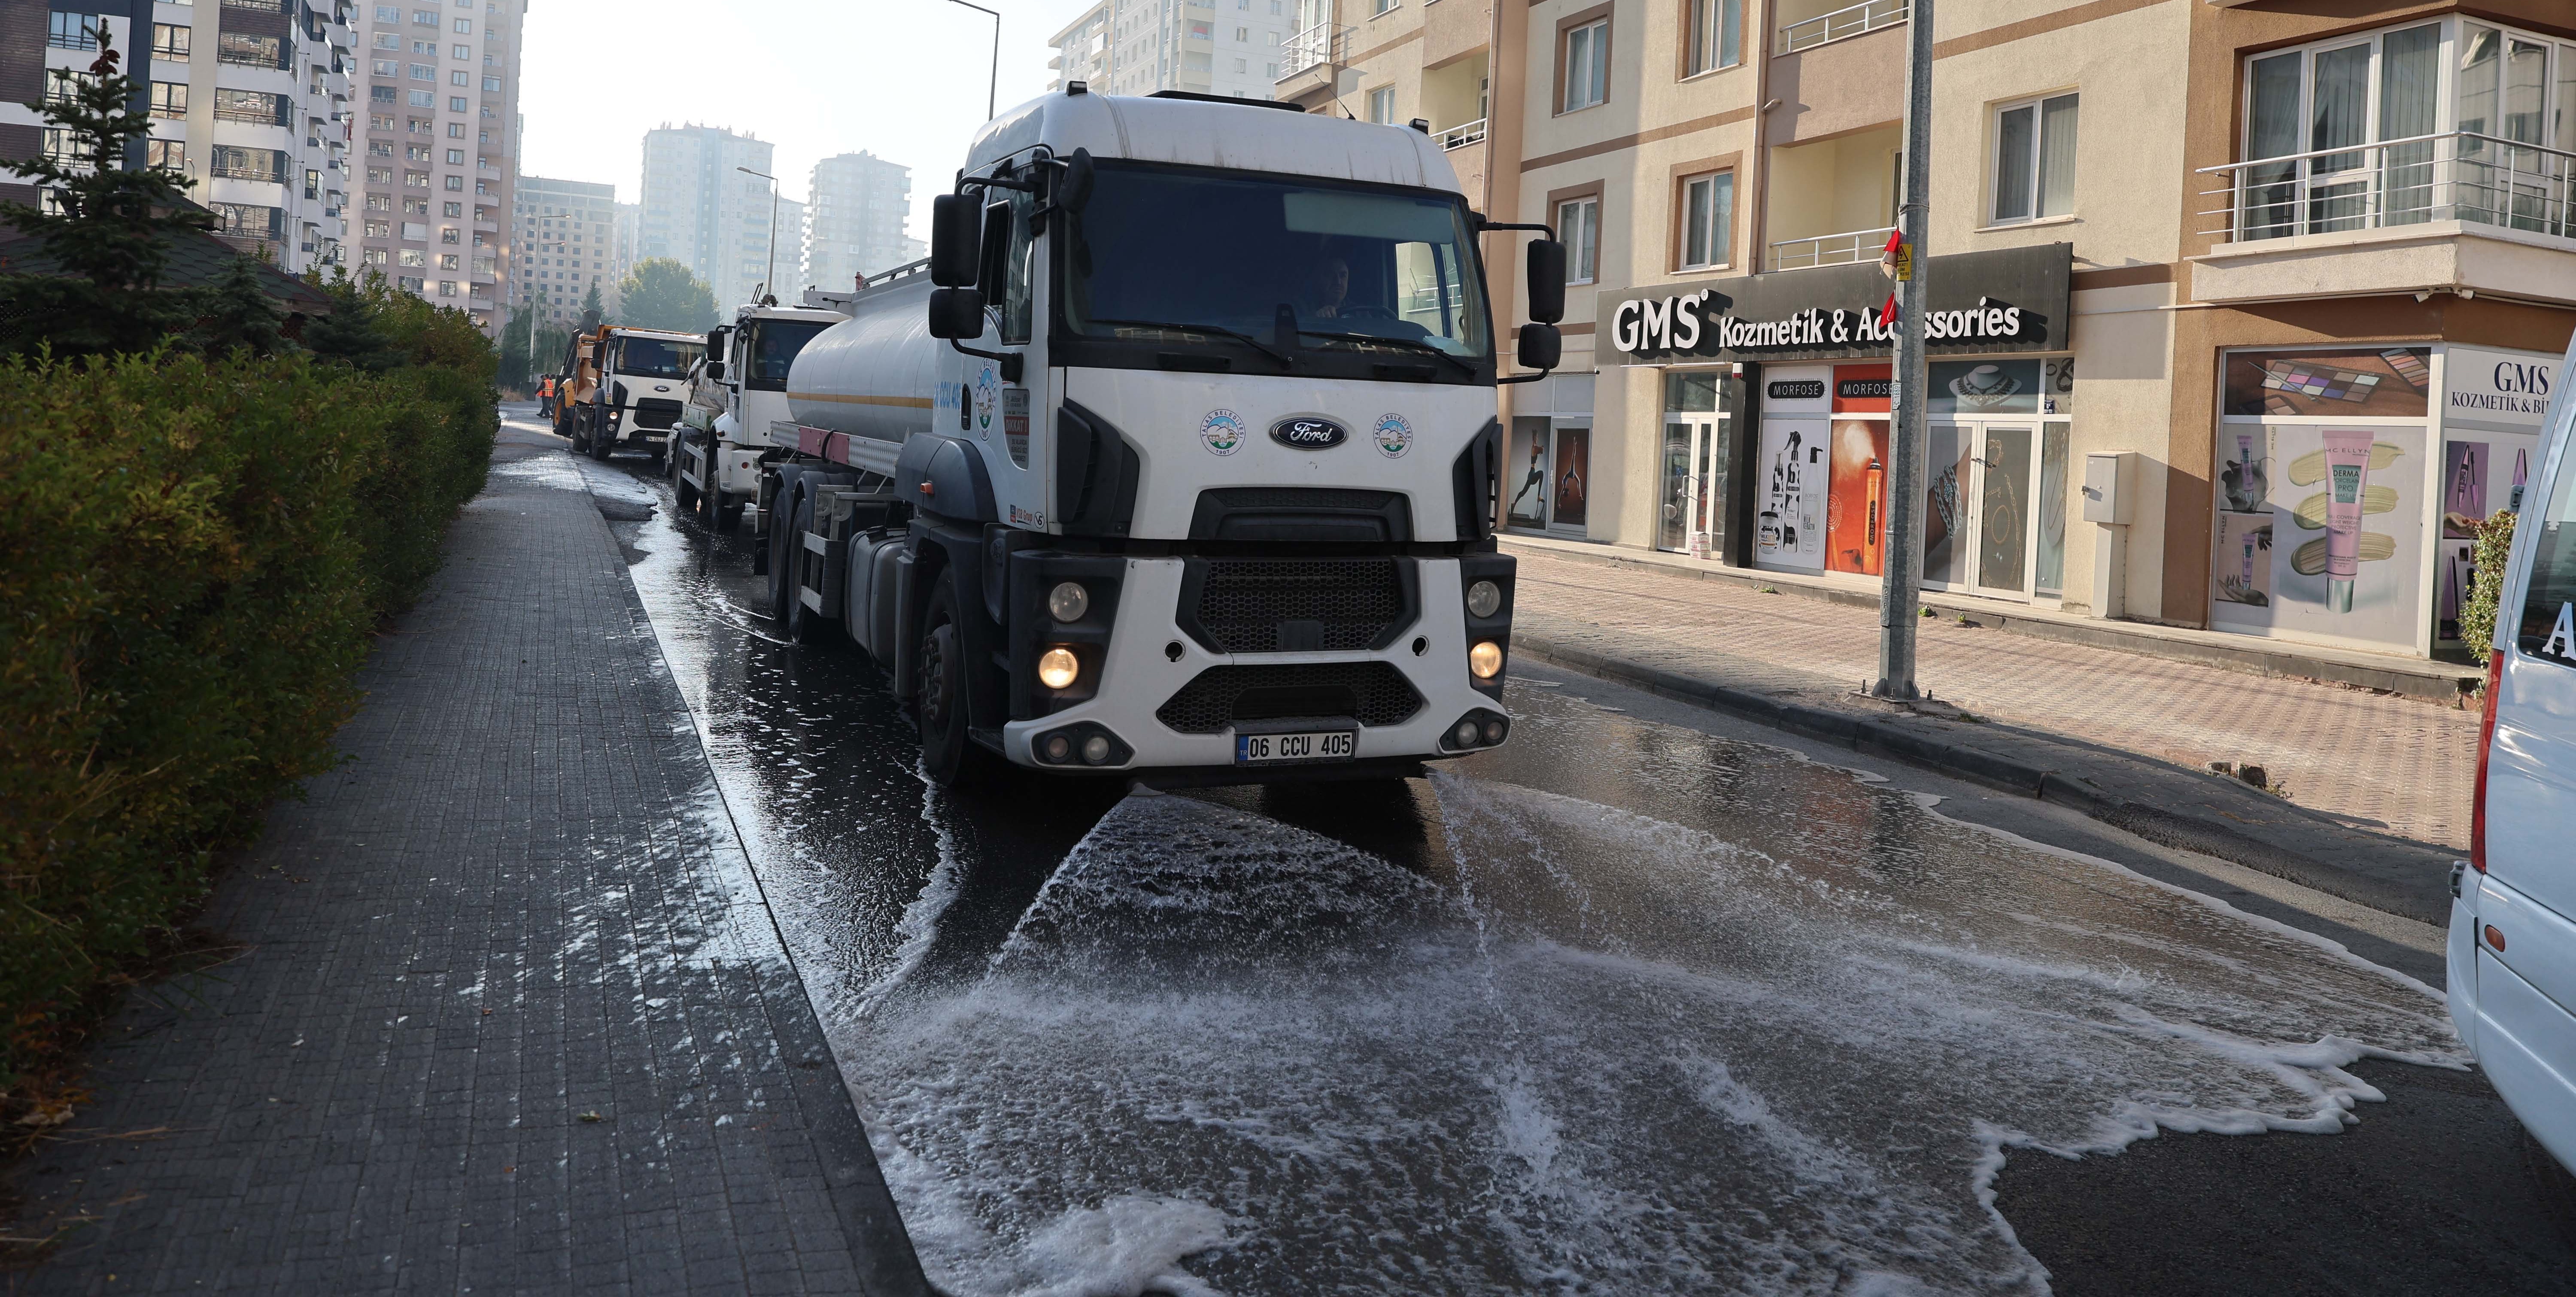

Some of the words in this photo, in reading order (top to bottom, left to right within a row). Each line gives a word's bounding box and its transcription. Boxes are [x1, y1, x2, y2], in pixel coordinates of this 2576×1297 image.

[1719, 307, 1824, 348] Kozmetik
[1830, 308, 1849, 343] &
[2494, 361, 2549, 395] GMS
[939, 381, 951, 408] CCU
[1773, 384, 1819, 396] MORFOSE
[2451, 392, 2519, 412] KOZMETİK
[2521, 398, 2530, 413] &
[1202, 415, 1212, 437] TALAS
[1290, 422, 1333, 442] Ford
[1375, 419, 1384, 440] TALAS
[1023, 510, 1033, 524] Grup
[1249, 738, 1270, 758] 06
[1280, 736, 1311, 756] CCU
[1321, 735, 1351, 755] 405
